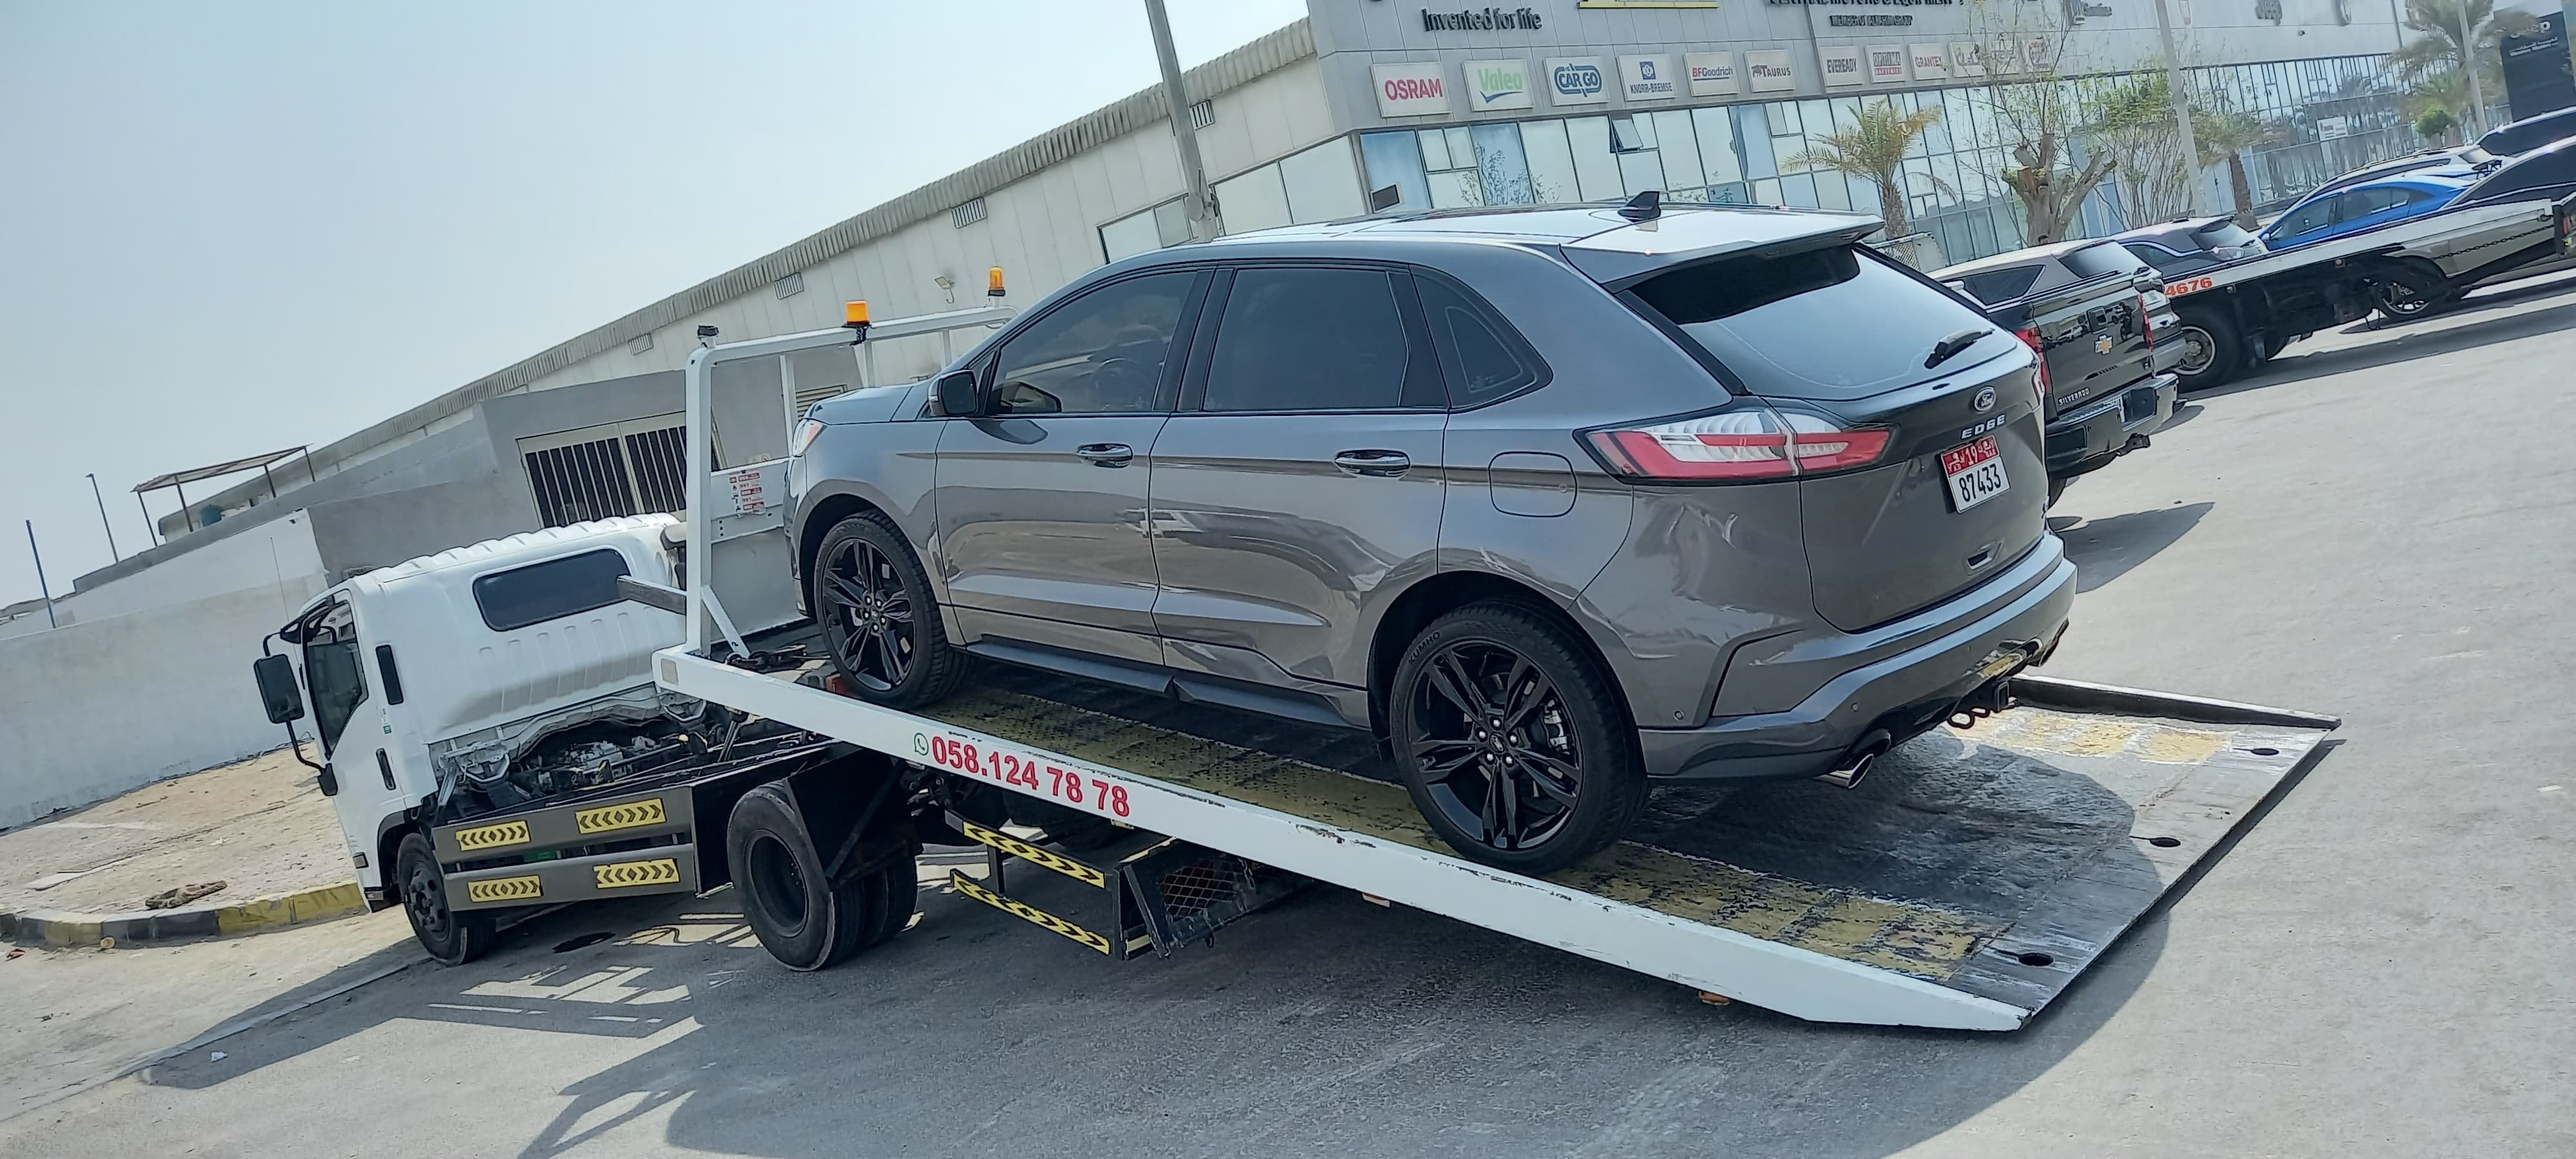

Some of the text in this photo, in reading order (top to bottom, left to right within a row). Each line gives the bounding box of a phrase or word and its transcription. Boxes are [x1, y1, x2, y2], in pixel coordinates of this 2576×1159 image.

[1421, 7, 1542, 32] Invented for life
[1692, 66, 1733, 77] BFGoodrich
[1827, 58, 1857, 73] EVEREADY
[1385, 78, 1443, 101] OSRAM
[1477, 68, 1523, 91] Valeo
[1630, 82, 1673, 95] KNORR-BREMSE
[2165, 278, 2213, 296] 4676
[2058, 388, 2090, 406] SILVERADO
[1961, 414, 2006, 439] EDGE
[1965, 446, 1978, 466] 19
[1959, 464, 2002, 502] 87433
[1408, 632, 1440, 664] KUMHO
[932, 737, 1130, 817] 058.124 78 78
